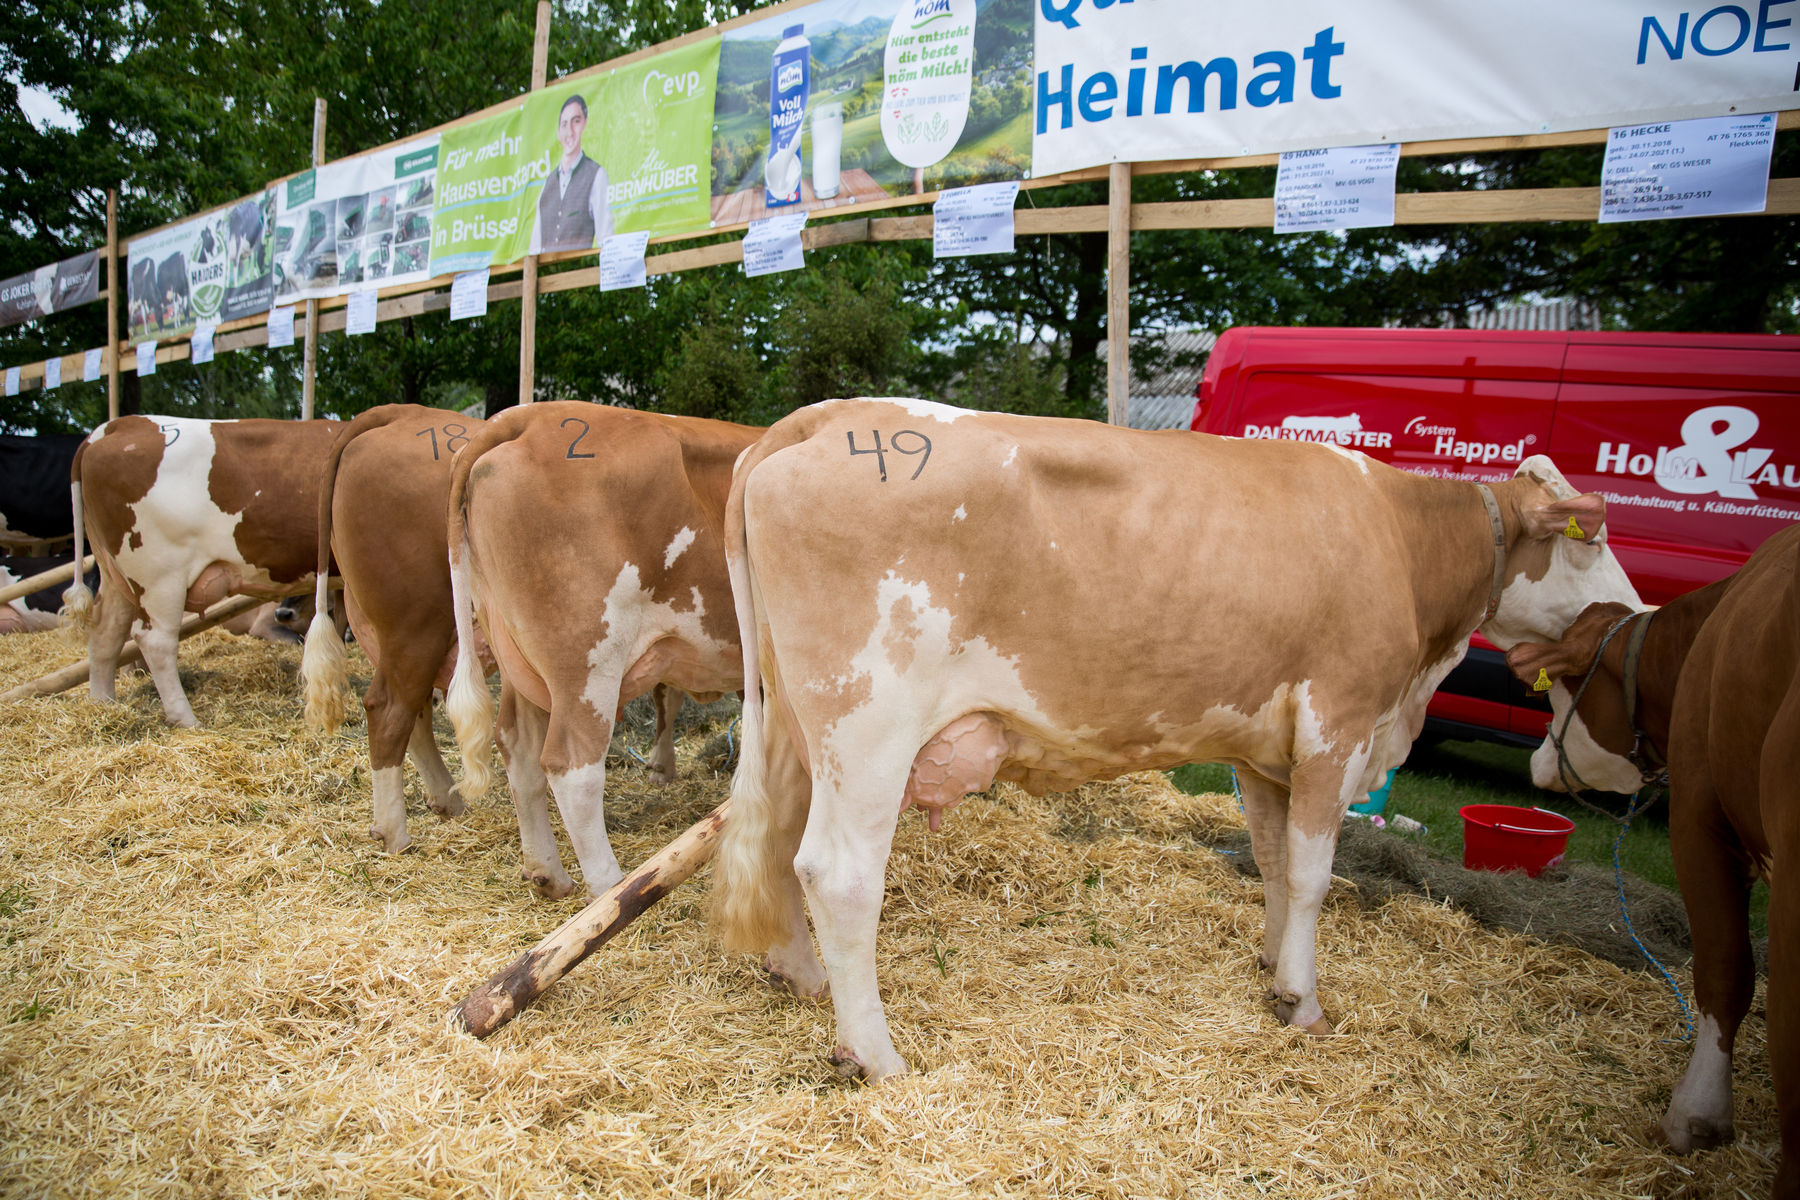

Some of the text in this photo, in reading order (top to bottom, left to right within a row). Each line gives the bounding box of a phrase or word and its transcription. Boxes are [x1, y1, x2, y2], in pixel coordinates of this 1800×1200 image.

[891, 25, 970, 47] Hier entsteht
[1636, 0, 1796, 65] NOE
[898, 44, 958, 64] die beste
[888, 58, 969, 84] nöm Milch!
[1037, 26, 1345, 135] Heimat
[663, 71, 700, 97] evp
[779, 95, 802, 112] Voll
[773, 109, 803, 129] Milch
[1613, 124, 1671, 140] 16 HECKE
[1729, 139, 1769, 149] Fleckvieh
[1733, 131, 1753, 140] 1765
[1755, 130, 1770, 138] 368
[443, 147, 472, 173] Für
[474, 131, 523, 163] mehr
[1669, 161, 1681, 169] GS
[1683, 158, 1712, 167] WESER
[439, 149, 550, 207] Hausverstand
[607, 163, 698, 203] BERNHUBER
[1652, 185, 1663, 193] kg
[435, 224, 447, 248] in
[161, 423, 180, 447] 5
[560, 418, 595, 459] 2
[1244, 424, 1393, 448] DAIRYMASTER
[1415, 423, 1456, 436] System
[847, 430, 932, 482] 49
[1435, 436, 1525, 464] Happel
[1687, 503, 1700, 511] u.
